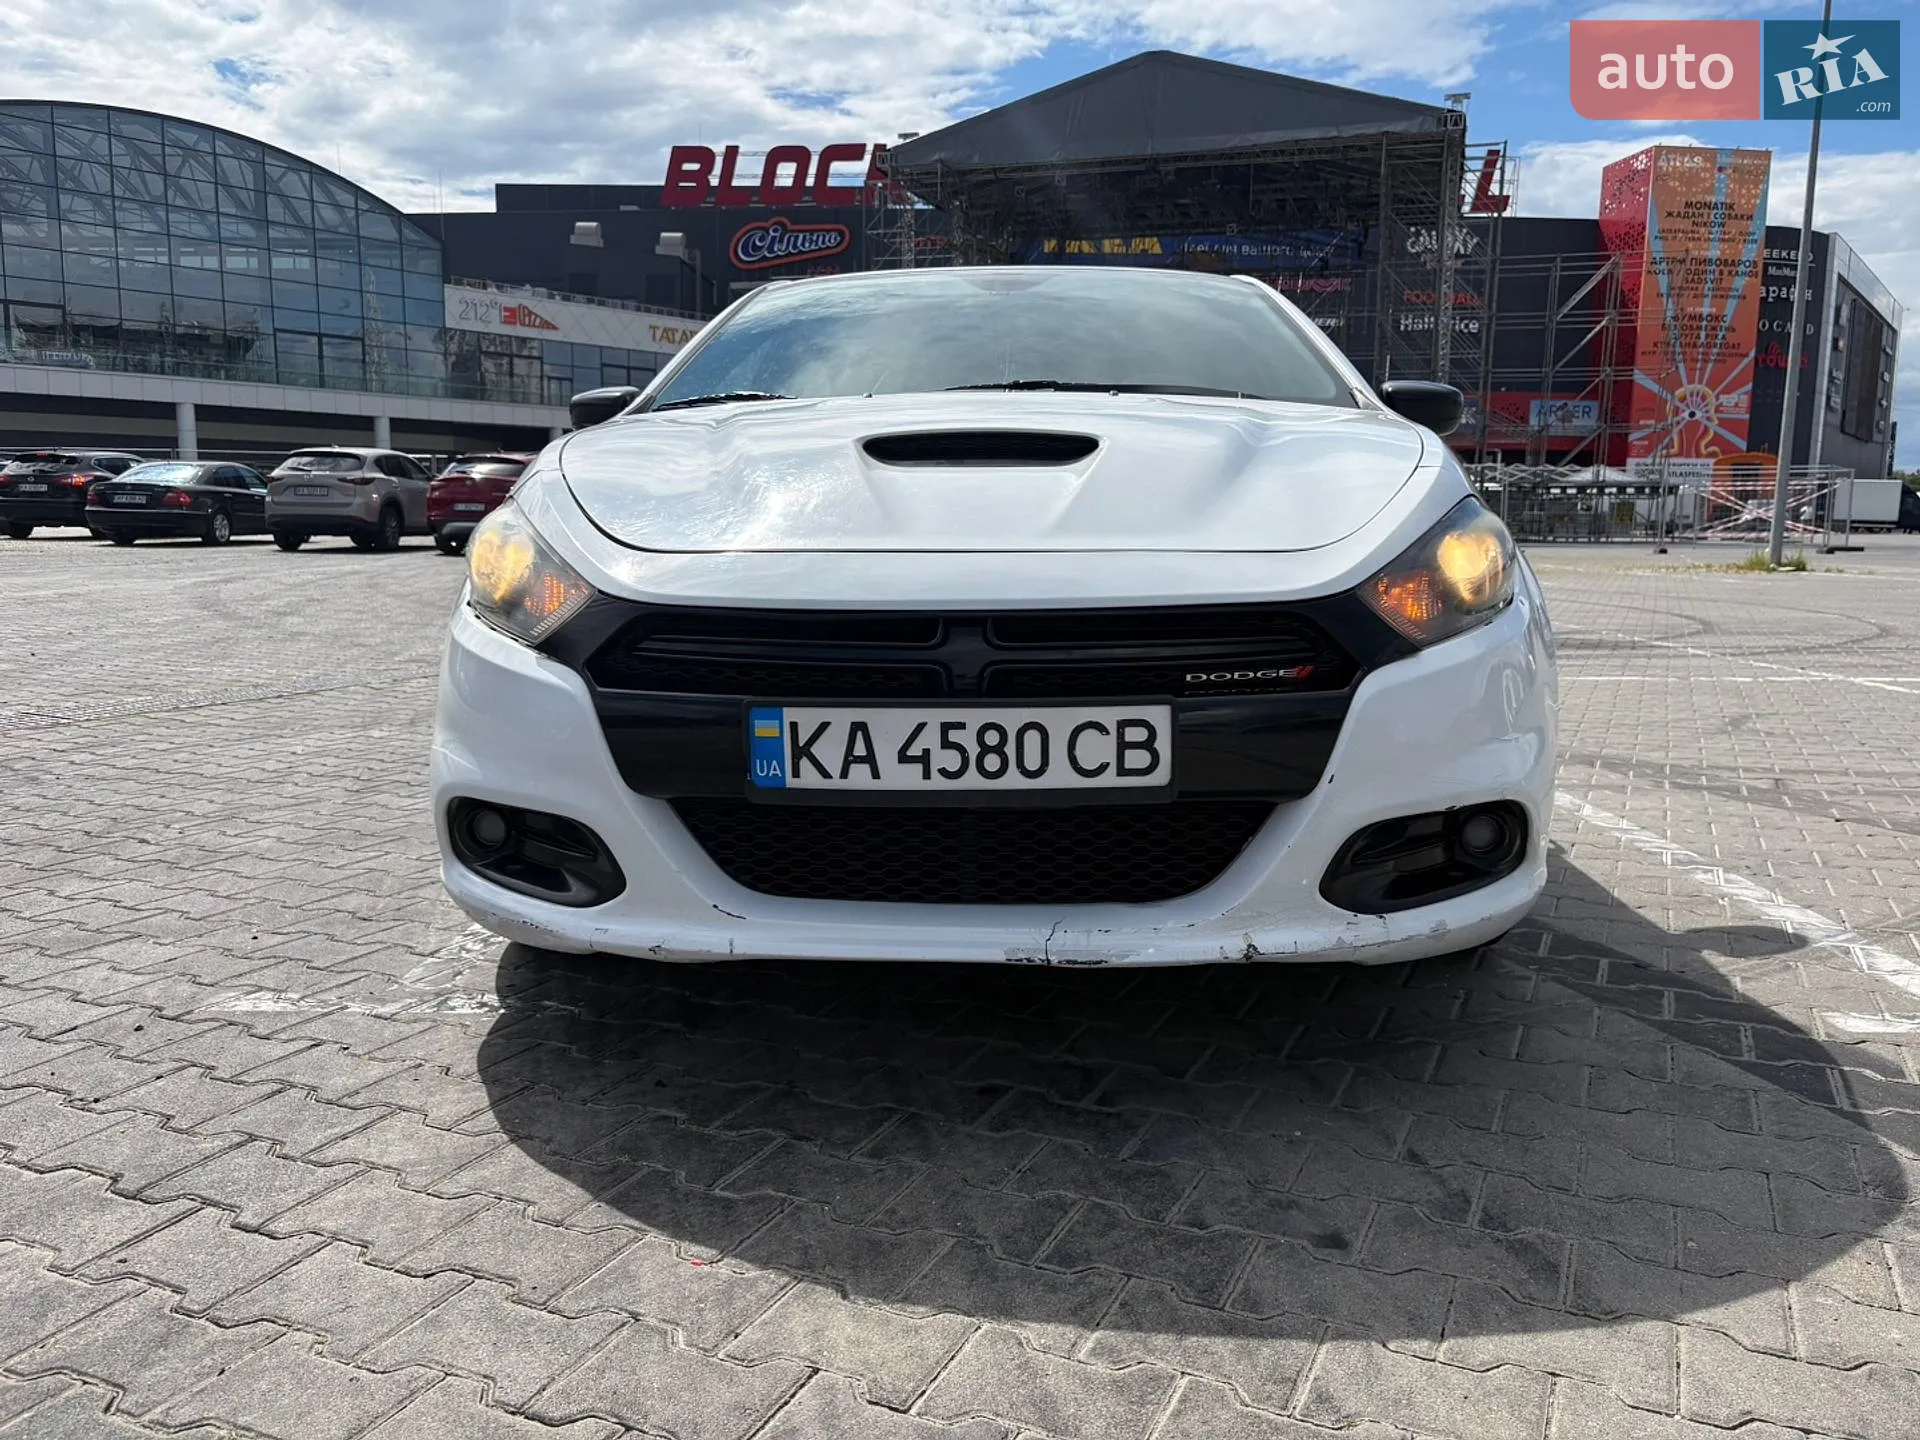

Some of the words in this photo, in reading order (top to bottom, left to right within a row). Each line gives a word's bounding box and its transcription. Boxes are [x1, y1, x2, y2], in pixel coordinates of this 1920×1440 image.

[1684, 200, 1736, 212] MONATIK
[737, 224, 841, 261] Сільпо
[1536, 404, 1592, 419] ARER
[1186, 669, 1299, 683] DODGE
[756, 758, 782, 777] UA
[789, 720, 881, 780] KA
[897, 720, 1050, 780] 4580
[1067, 719, 1160, 778] CB
